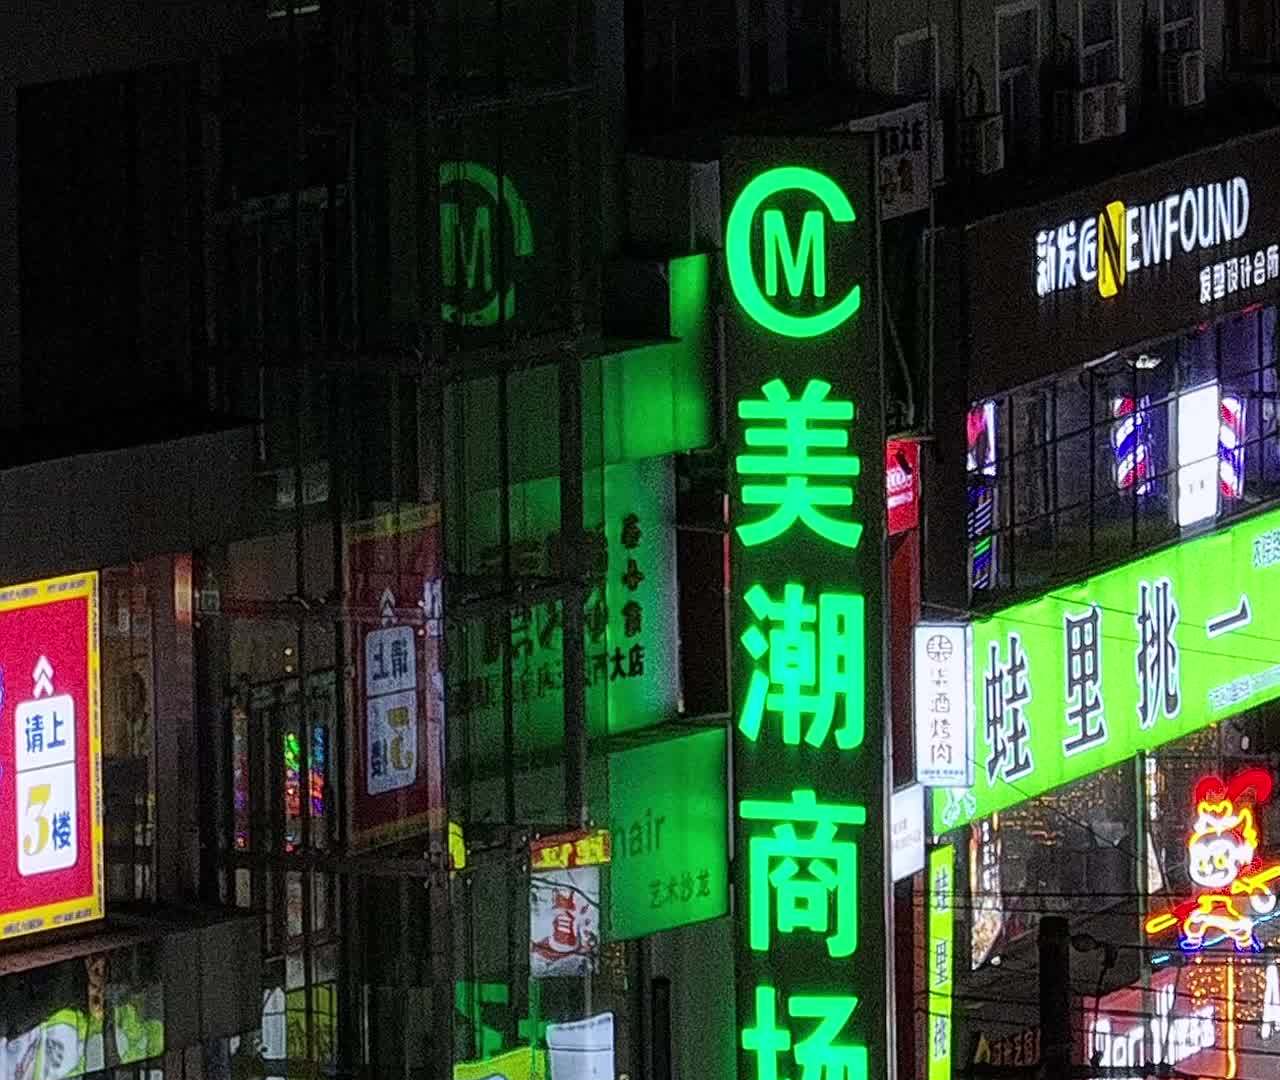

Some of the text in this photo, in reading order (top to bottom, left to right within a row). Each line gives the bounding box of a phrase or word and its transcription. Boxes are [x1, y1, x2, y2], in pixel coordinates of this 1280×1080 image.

[1098, 176, 1249, 297] NEWFOUND
[984, 575, 1252, 787] 蛙里挑一
[24, 710, 67, 755] 请上
[22, 783, 73, 858] 3楼
